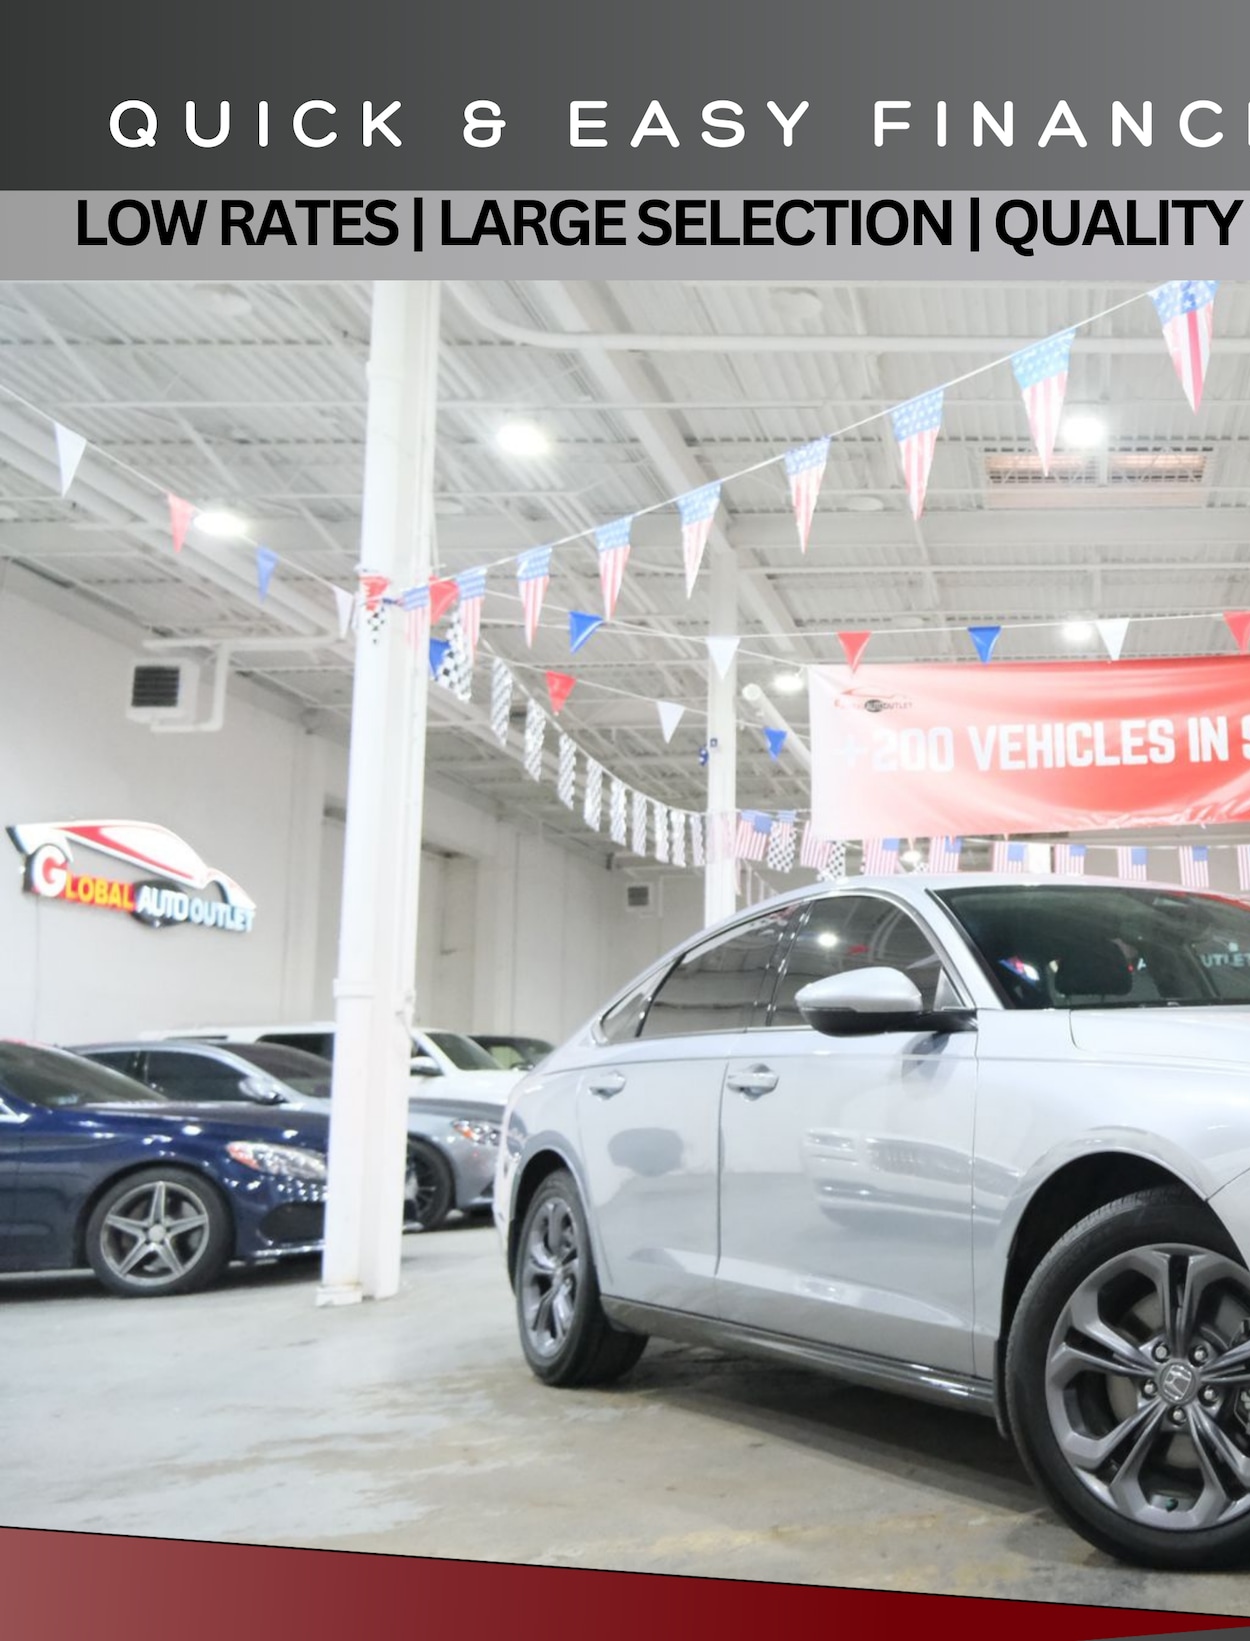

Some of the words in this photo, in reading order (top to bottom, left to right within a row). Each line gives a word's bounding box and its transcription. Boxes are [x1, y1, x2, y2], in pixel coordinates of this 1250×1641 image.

[967, 718, 1176, 772] VEHICLES
[1187, 715, 1230, 763] IN
[32, 844, 135, 911] GLOBAL
[136, 885, 189, 922] AUTO
[190, 896, 256, 933] OUTLET
